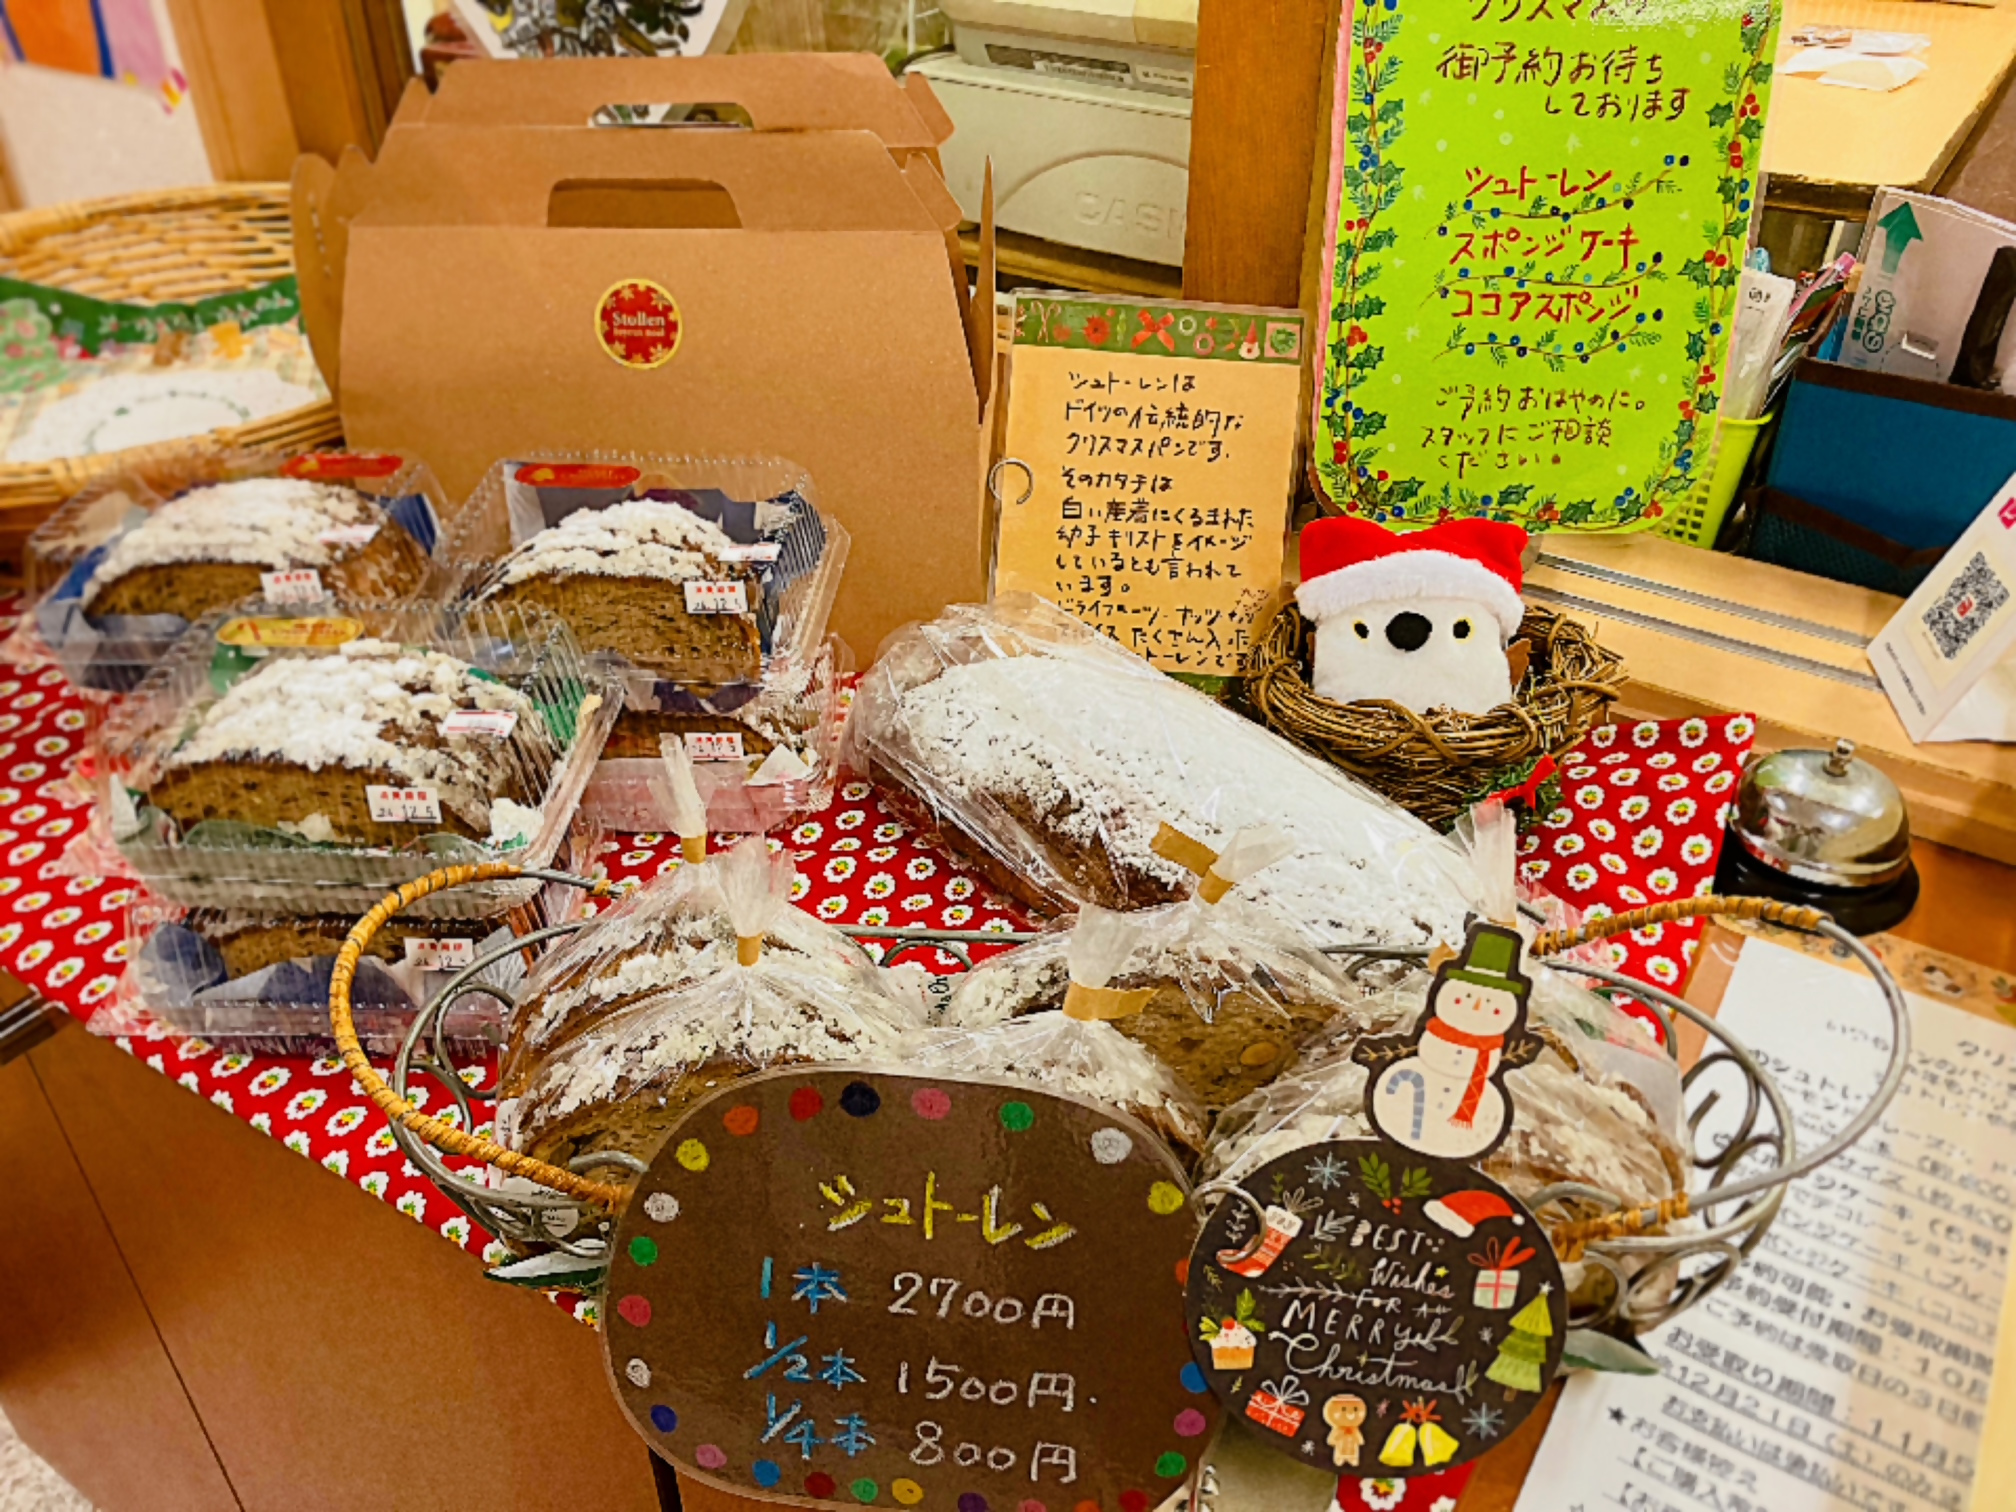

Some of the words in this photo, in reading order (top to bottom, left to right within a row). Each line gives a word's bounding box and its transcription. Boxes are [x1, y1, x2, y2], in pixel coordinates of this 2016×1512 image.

[1436, 42, 1664, 87] 御予約お待ち
[1545, 87, 1691, 122] しております
[1464, 166, 1614, 200] シュトーレン
[1073, 191, 1188, 240] CASI
[1452, 284, 1640, 325] ココアスポンジ
[1068, 371, 1196, 396] シュトーレンは
[1435, 383, 1646, 422] ご予約おはやめに。
[1065, 398, 1245, 438] ドイツの伝統的な
[1421, 418, 1612, 449] スタッフにご相談
[1061, 465, 1174, 494] そのカタチは
[1438, 452, 1562, 479] ください。
[1062, 496, 1255, 528] 白い産着にくるまれた
[1055, 525, 1253, 553] 幼子キリストをイメージ
[1055, 548, 1243, 580] しているとも言われて
[1055, 575, 1132, 597] います。
[1130, 626, 1251, 652] たくさん入った
[819, 1171, 1077, 1249] シュトーレン
[1350, 1219, 1427, 1256] BEST
[759, 1256, 847, 1314] 1本
[887, 1271, 1076, 1331] 2700円
[1368, 1256, 1456, 1299] Wishes
[1281, 1299, 1418, 1352] MERRY
[743, 1320, 868, 1391] 1/2本
[1267, 1330, 1453, 1395] Christmas
[760, 1392, 877, 1461] 1/4本
[909, 1420, 1078, 1484] 800円
